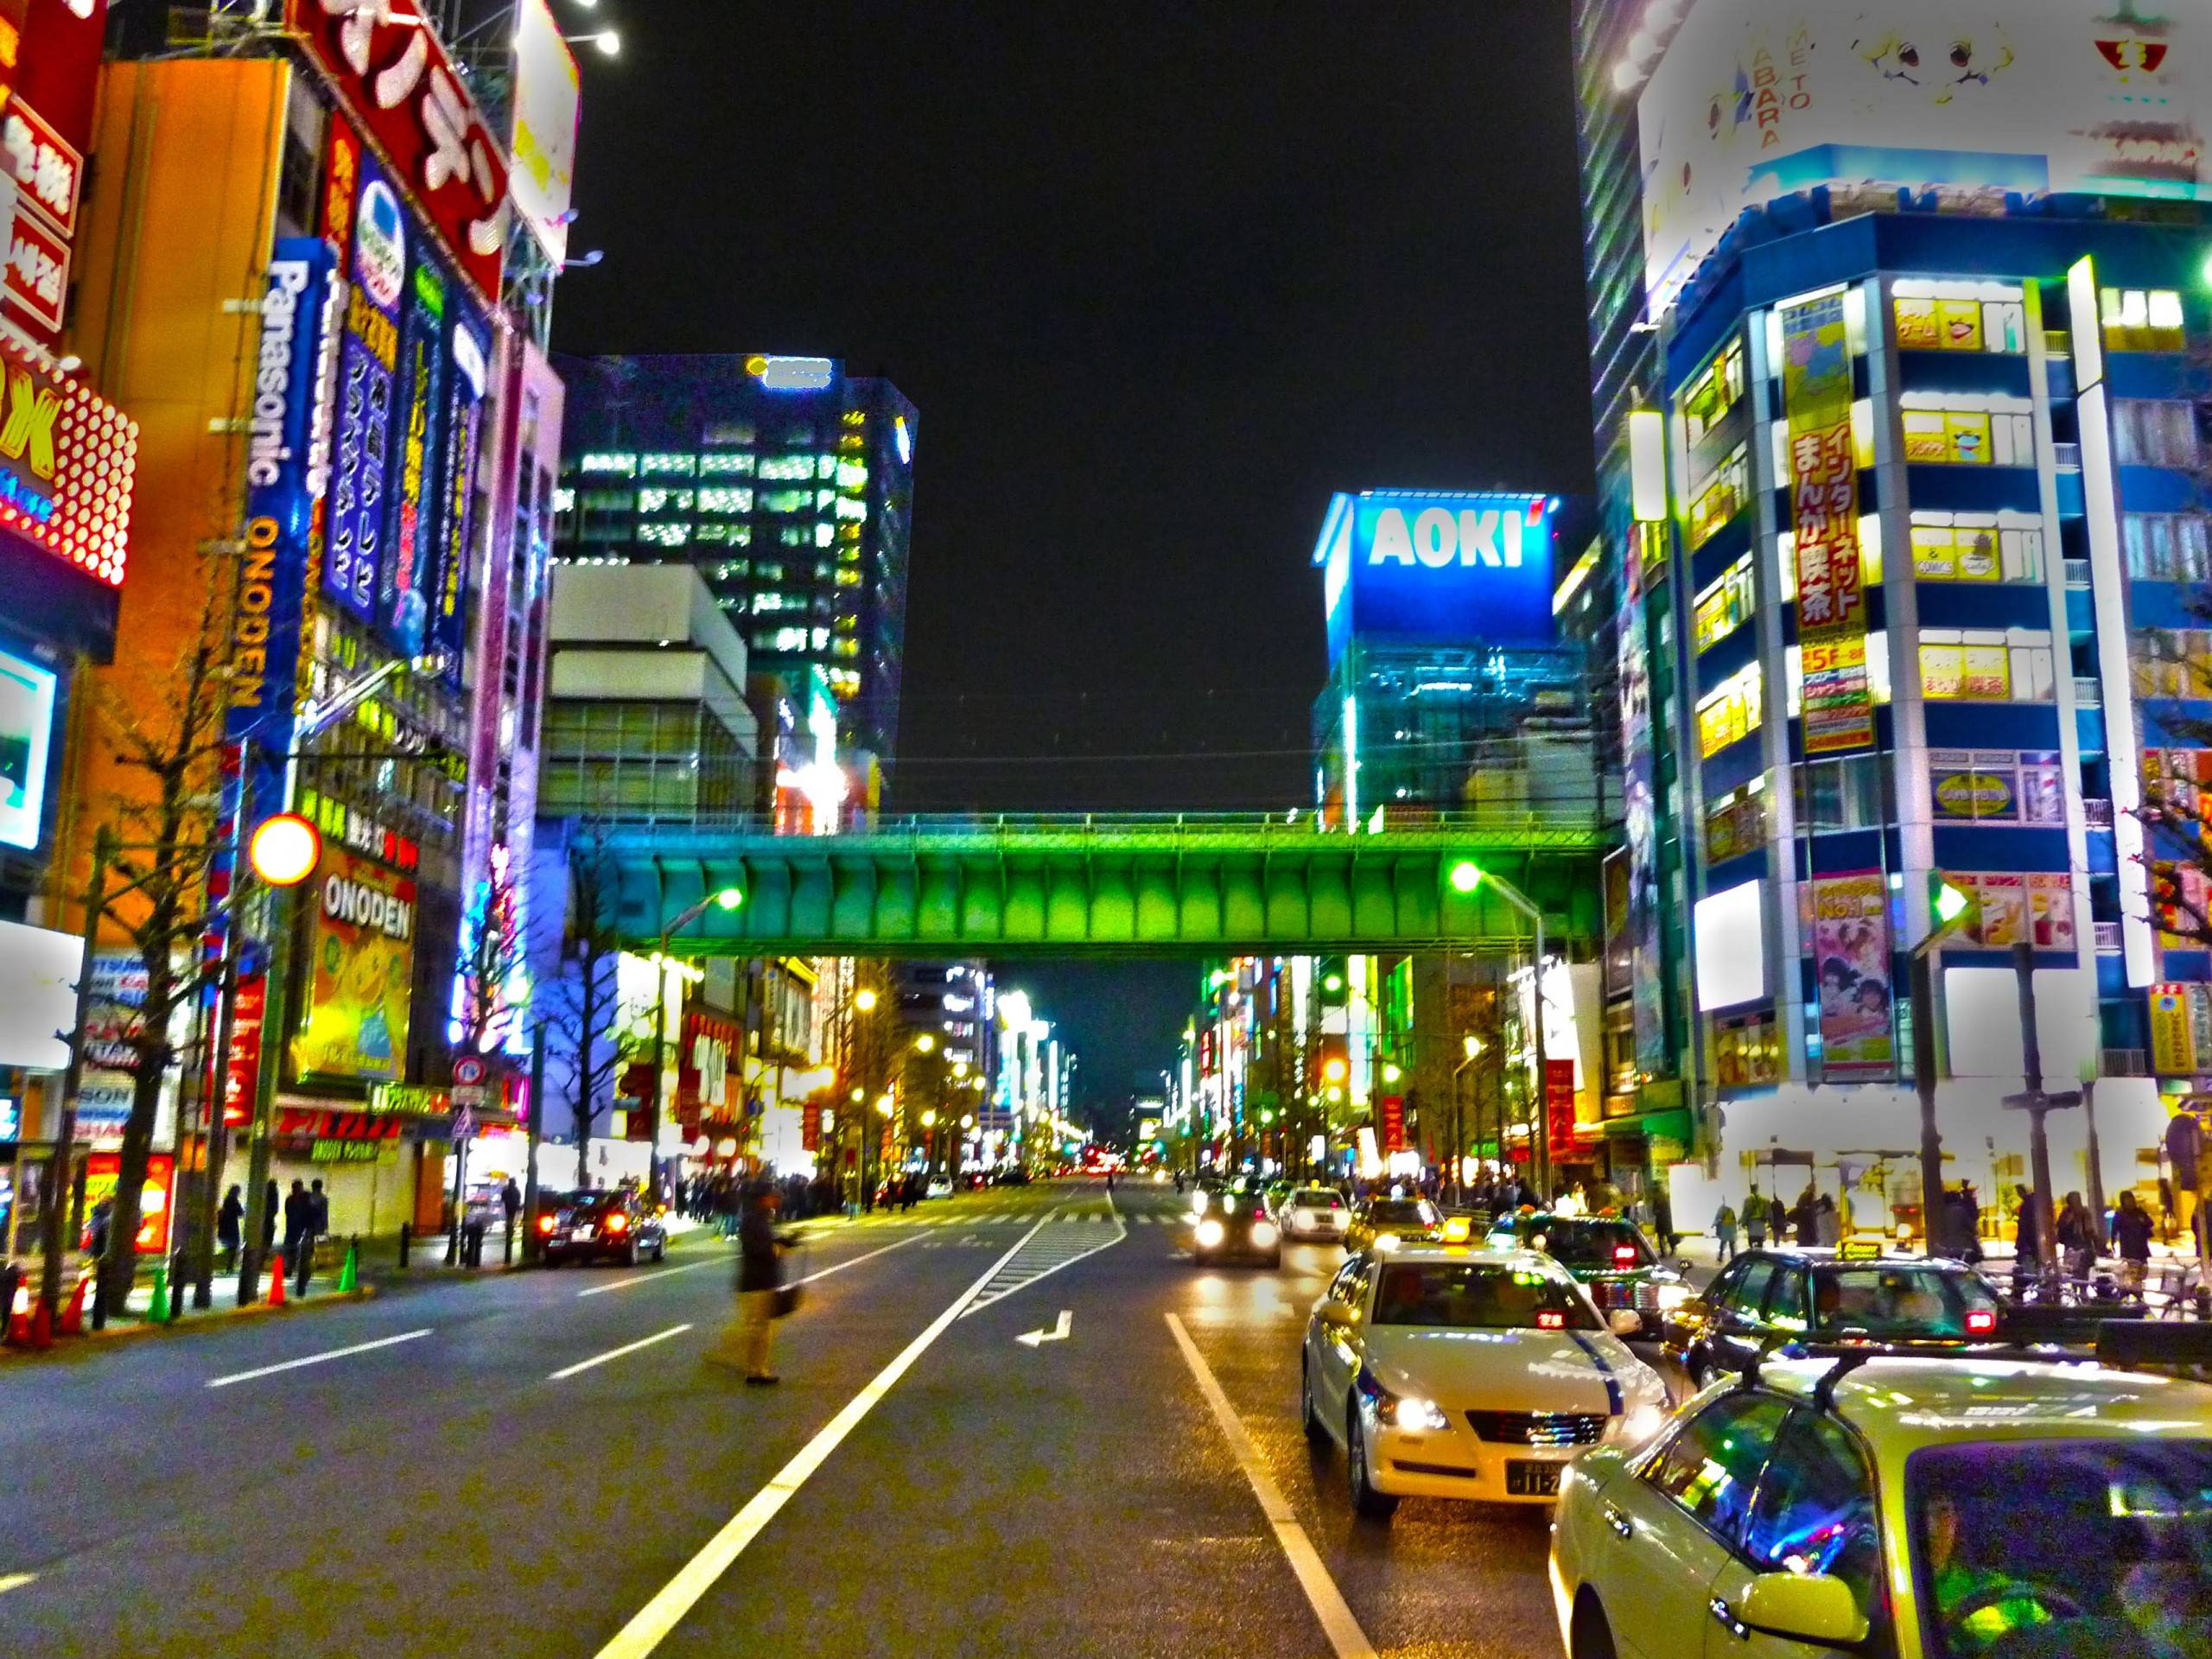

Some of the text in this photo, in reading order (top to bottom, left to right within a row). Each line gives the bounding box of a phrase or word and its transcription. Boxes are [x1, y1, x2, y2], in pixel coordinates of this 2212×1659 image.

[249, 261, 309, 486] Panasonic
[232, 516, 280, 707] ONODEN
[1368, 507, 1522, 568] AOKI
[1794, 434, 1834, 625] まんが喫茶
[1825, 425, 1859, 622] インターネット
[326, 873, 410, 940] ONODEN
